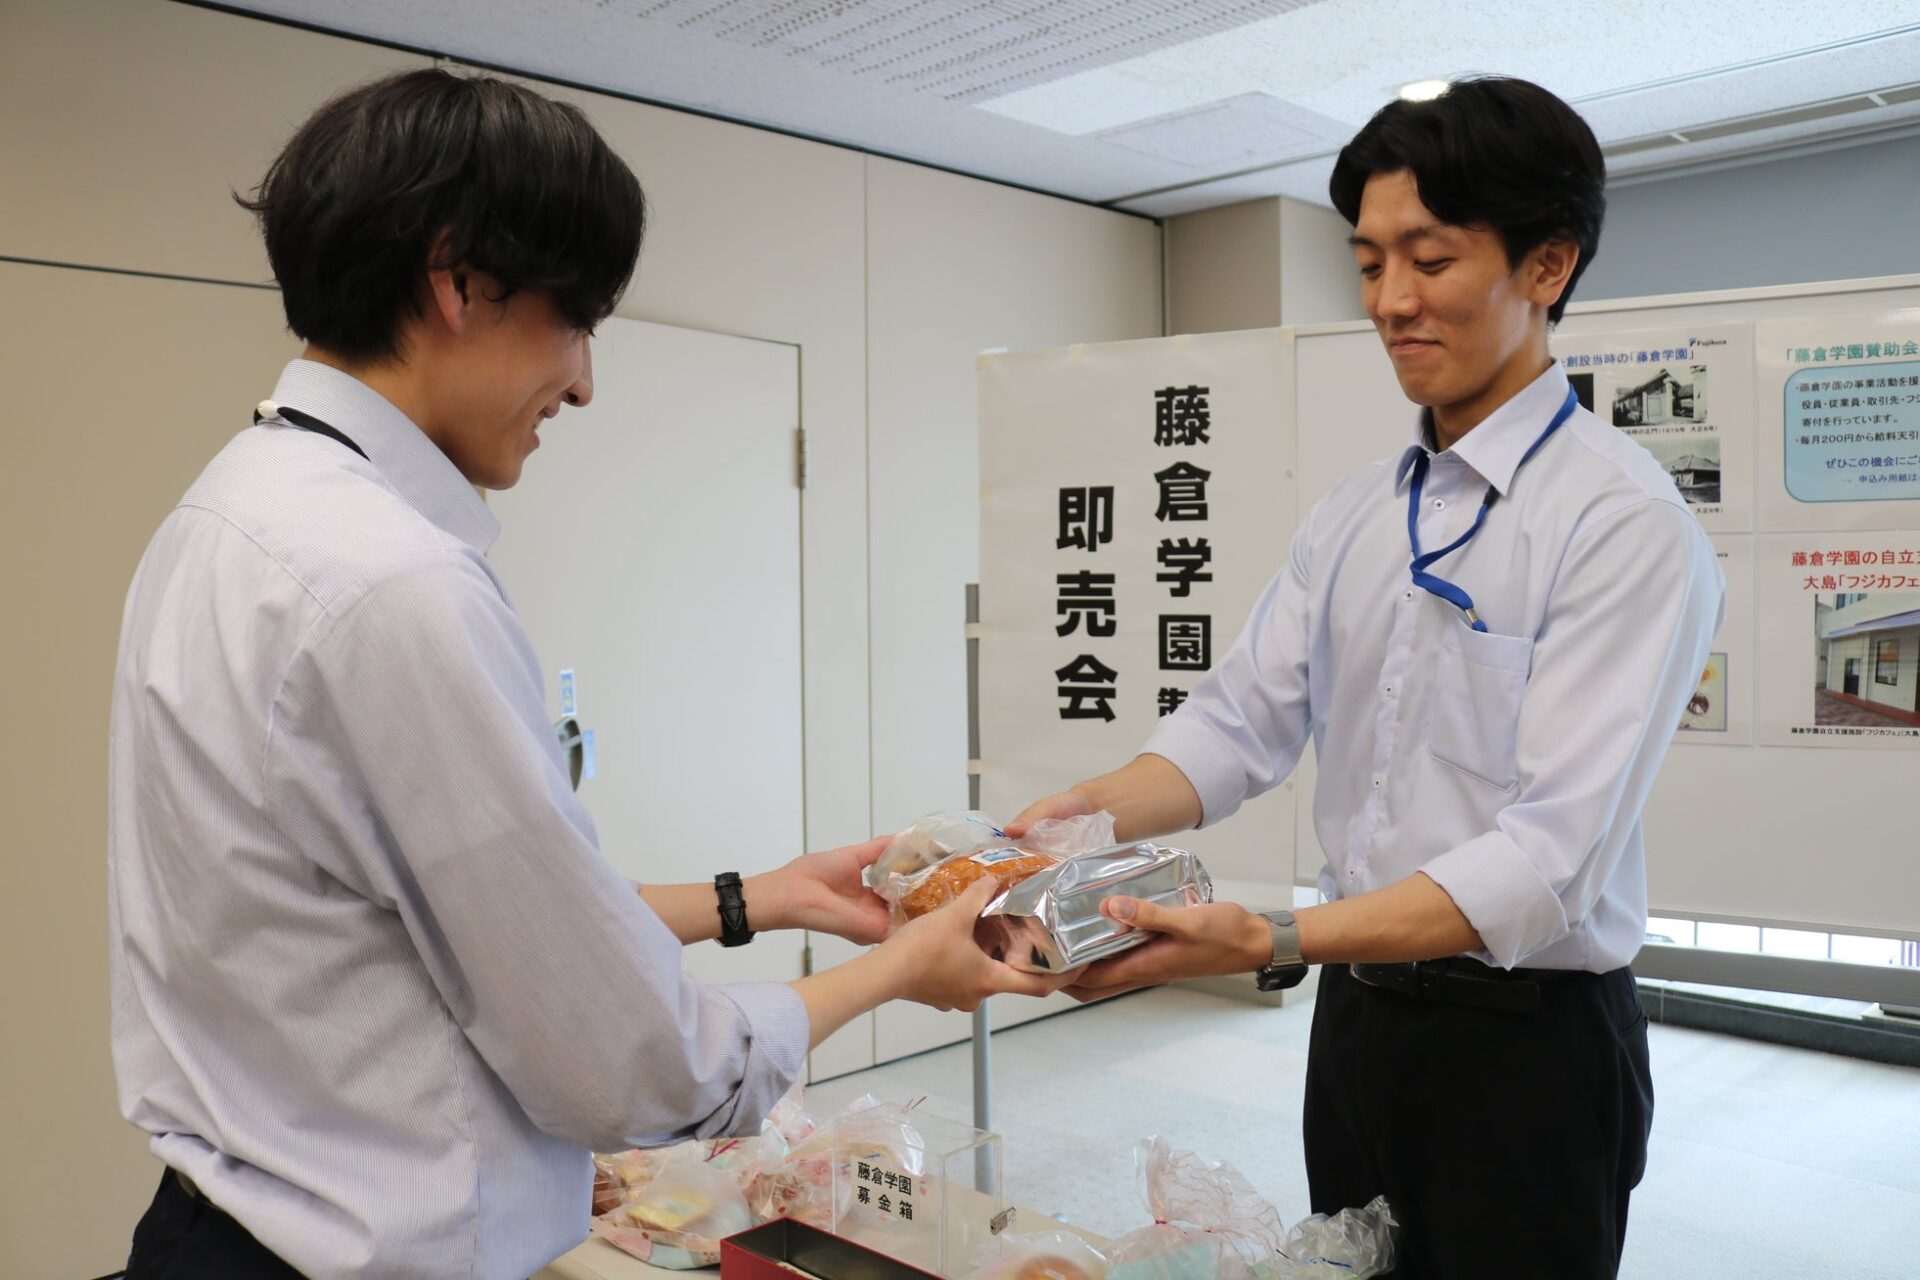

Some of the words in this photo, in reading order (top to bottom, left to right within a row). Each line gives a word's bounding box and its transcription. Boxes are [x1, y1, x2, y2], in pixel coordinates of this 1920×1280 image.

[1826, 455, 1920, 469] ぜひこの機会にご
[1858, 473, 1920, 484] 申込み用紙は
[1791, 549, 1920, 567] 藤倉学園の自立
[1803, 574, 1919, 590] 大島「フジカフェ
[1055, 486, 1118, 723] 即売会
[857, 1161, 912, 1196] 藤倉学園
